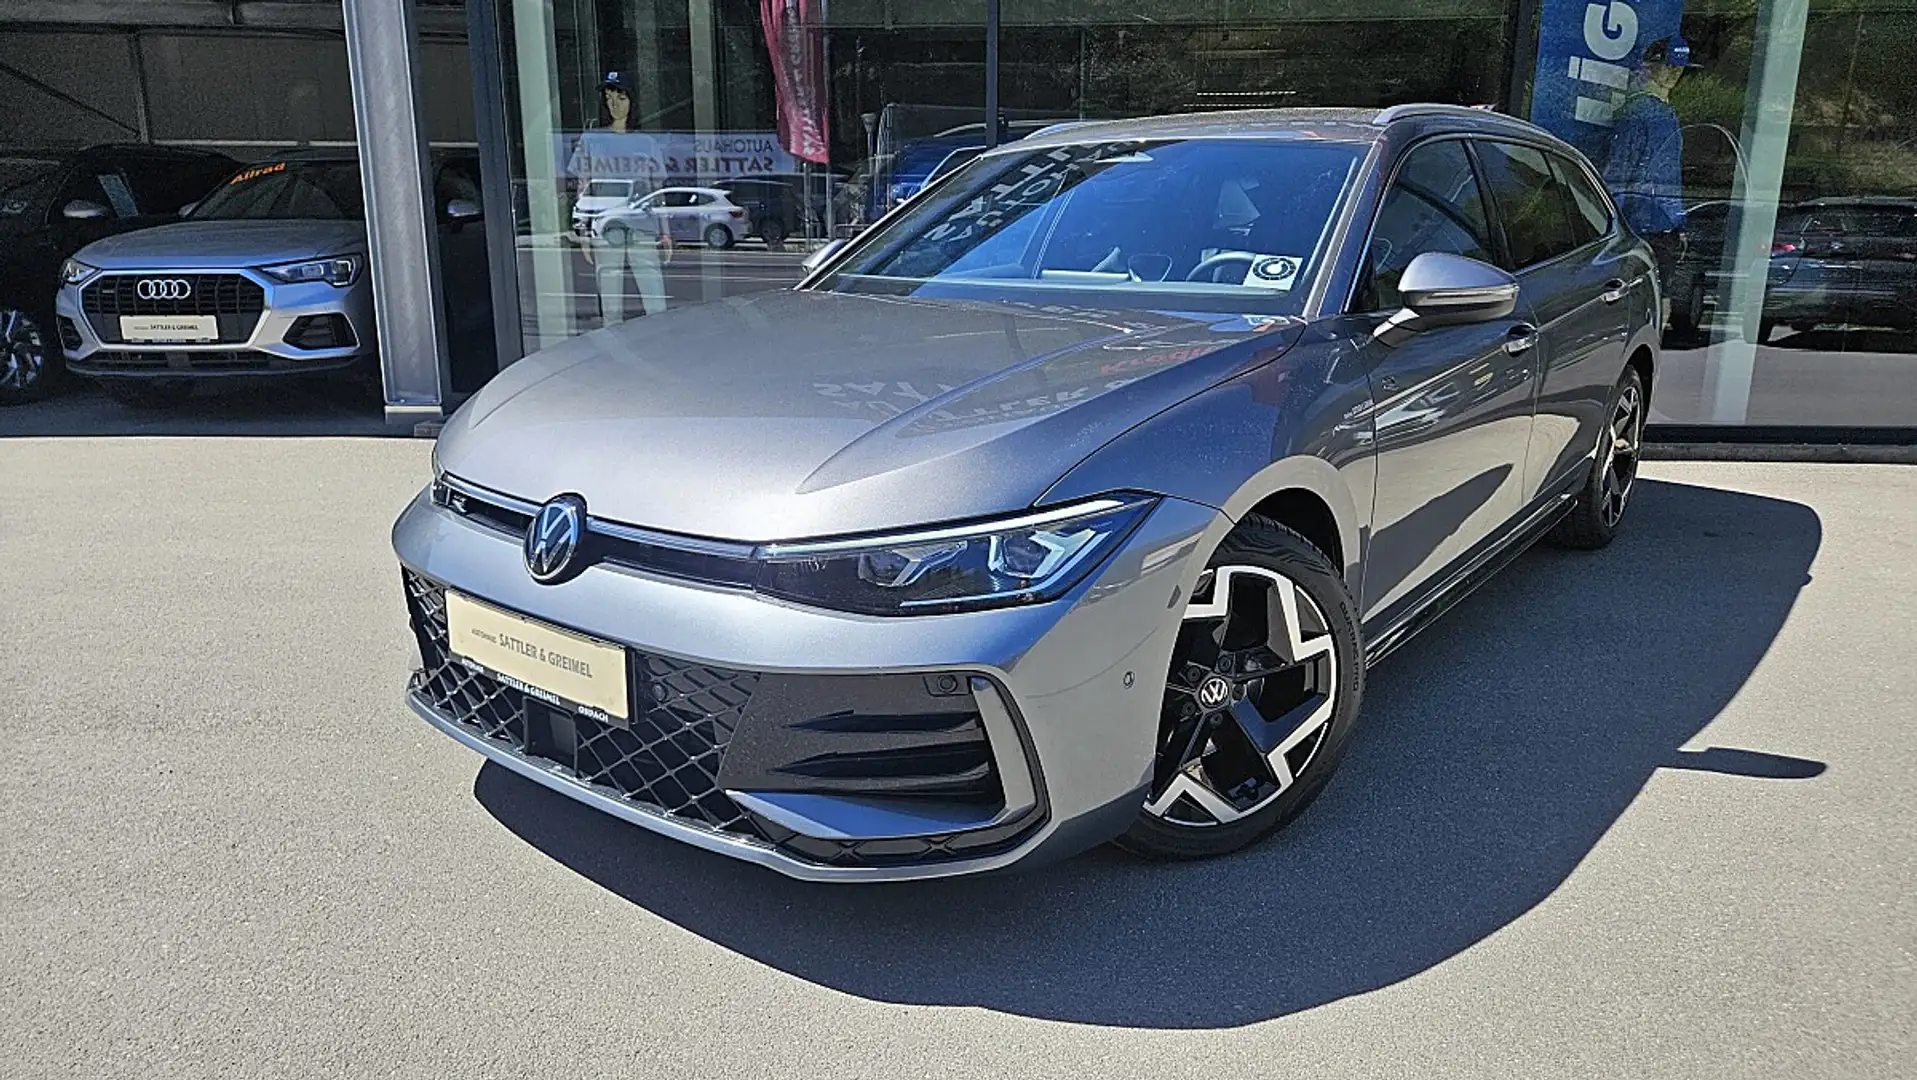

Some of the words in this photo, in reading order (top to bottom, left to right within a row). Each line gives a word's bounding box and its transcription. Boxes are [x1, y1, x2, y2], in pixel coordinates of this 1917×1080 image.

[231, 162, 286, 184] Allrad
[500, 633, 537, 660] SATTLER
[539, 648, 546, 663] &
[547, 651, 593, 679] GREIMEL
